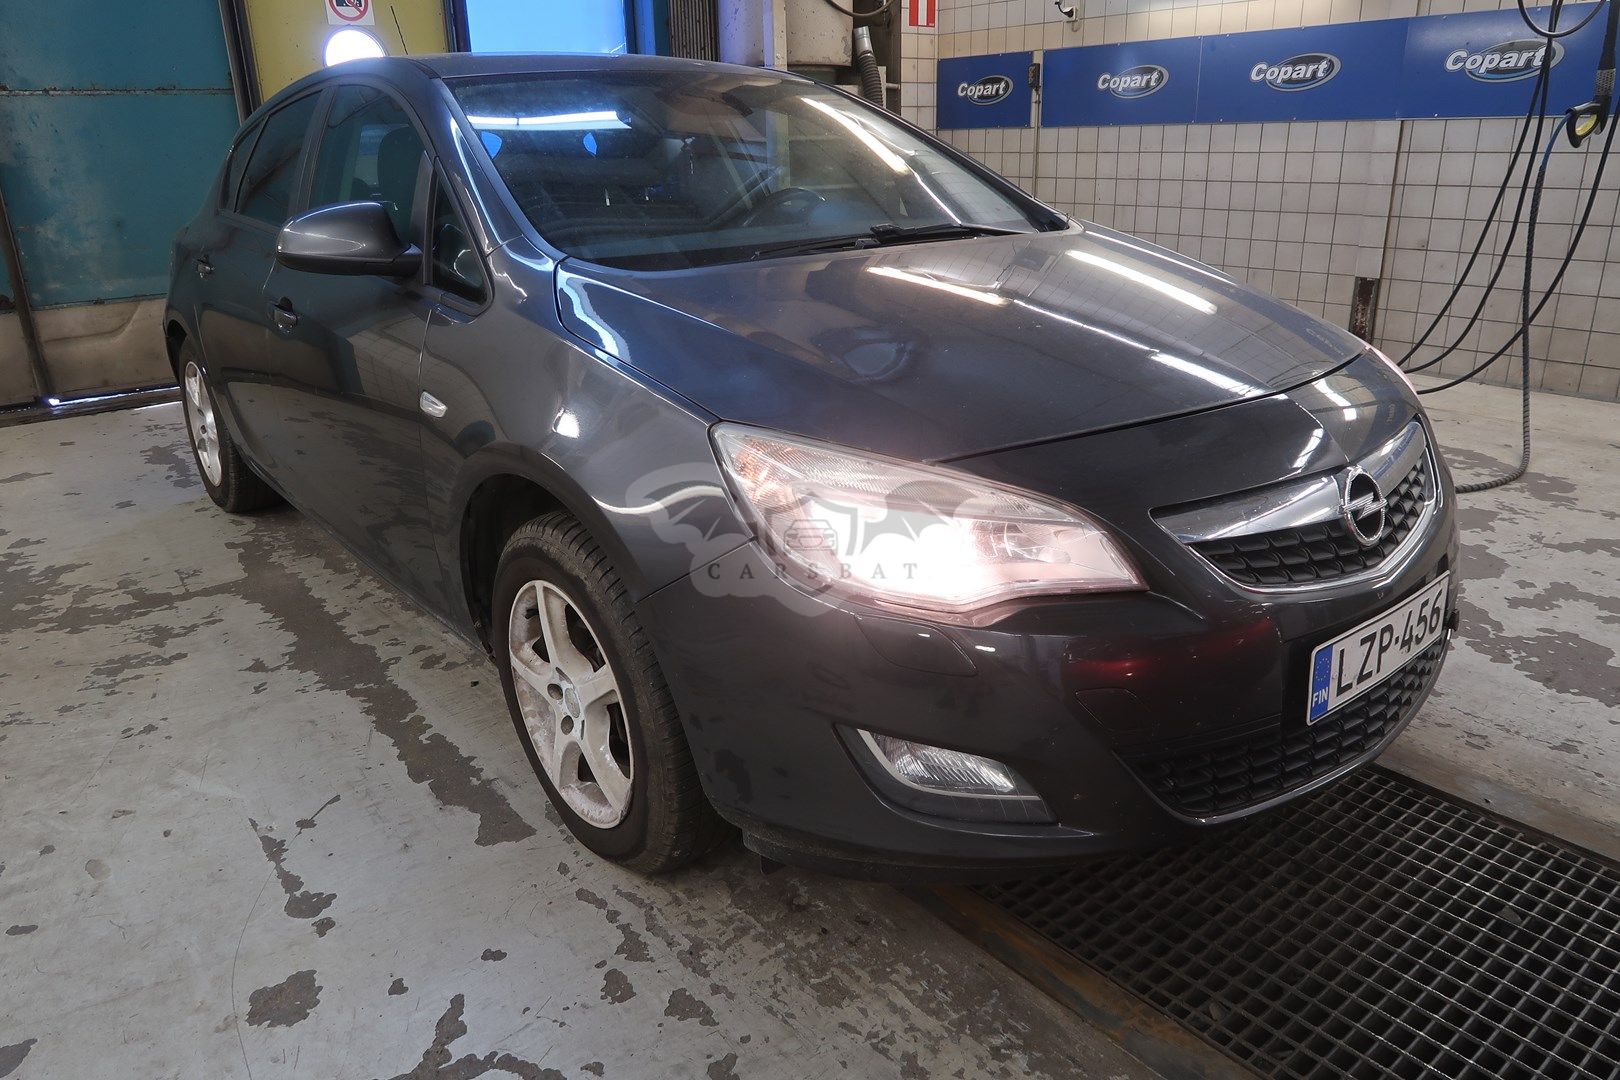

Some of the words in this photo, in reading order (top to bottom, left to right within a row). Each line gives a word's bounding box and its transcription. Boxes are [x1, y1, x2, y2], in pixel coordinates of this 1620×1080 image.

[1445, 44, 1546, 74] Copart
[1097, 70, 1159, 92] Copart
[1250, 60, 1328, 84] Copart
[957, 80, 1007, 99] Copart
[1336, 588, 1443, 698] LZP-456
[1312, 686, 1329, 708] FIN
